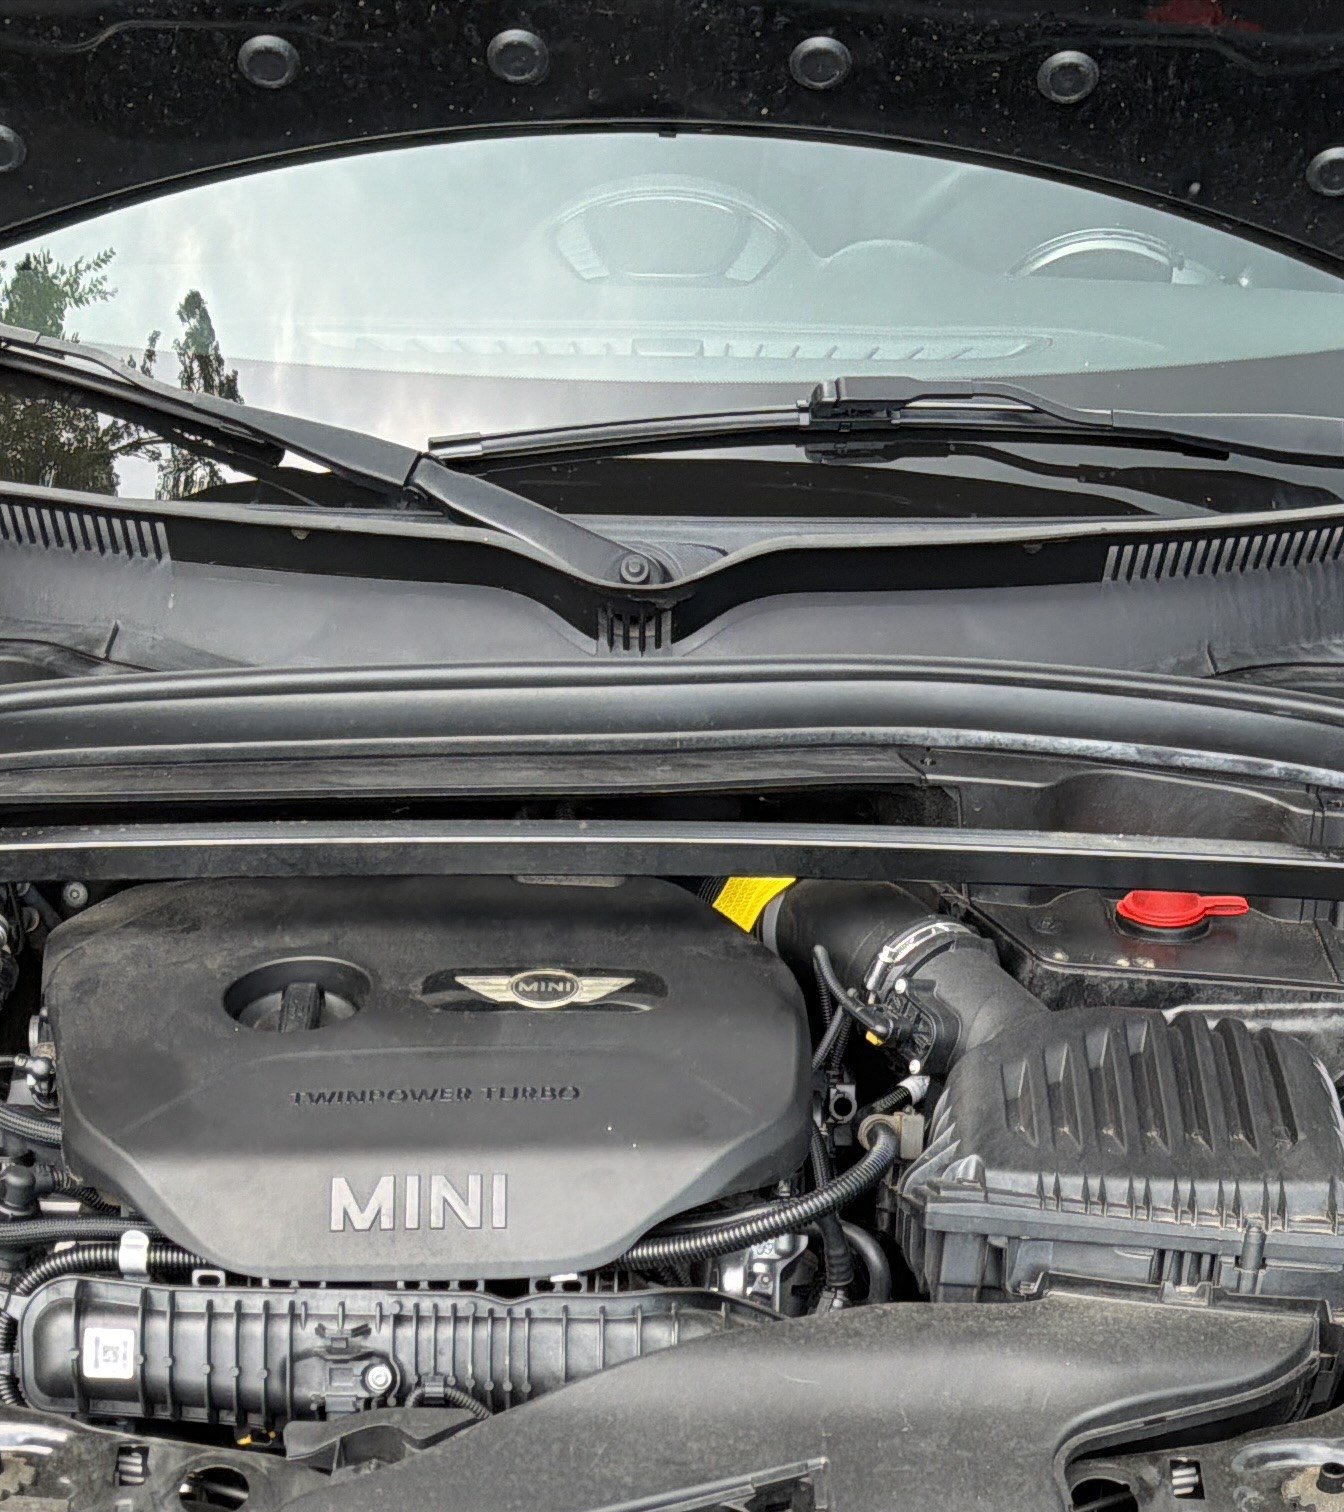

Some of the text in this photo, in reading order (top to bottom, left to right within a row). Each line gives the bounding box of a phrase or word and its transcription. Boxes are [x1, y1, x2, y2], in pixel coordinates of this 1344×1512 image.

[518, 980, 572, 992] MINI
[290, 1085, 581, 1105] TWINPOWER TURBO
[329, 1173, 508, 1233] MINI
